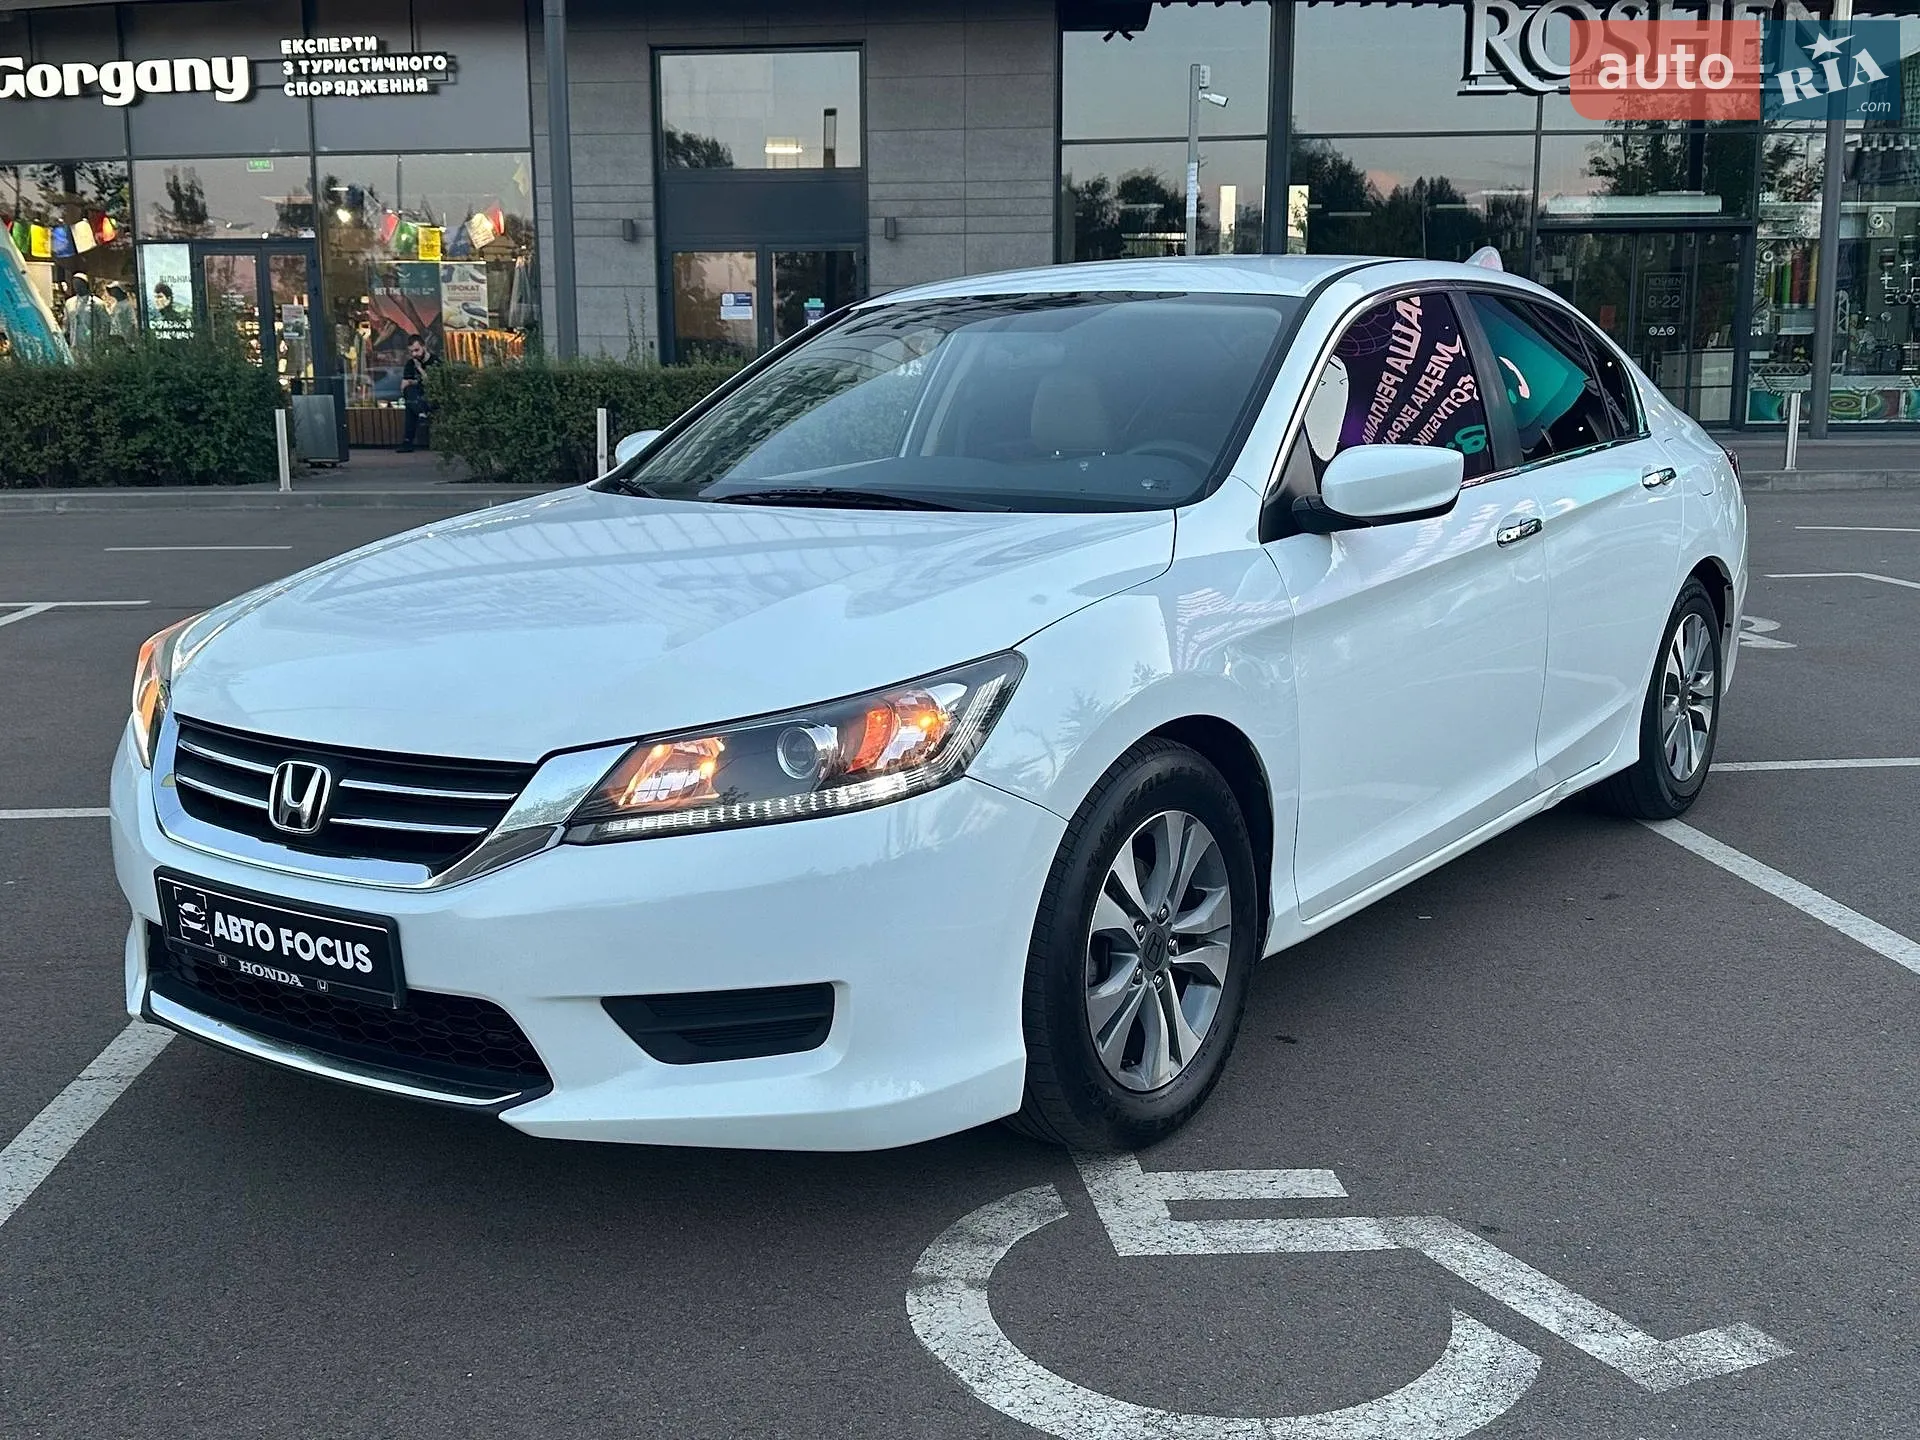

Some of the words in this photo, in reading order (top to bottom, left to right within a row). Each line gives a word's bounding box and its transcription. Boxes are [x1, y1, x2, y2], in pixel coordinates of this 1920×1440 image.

[280, 36, 377, 54] ЕКСПЕРТИ
[1471, 0, 1834, 92] ROSHEN
[282, 61, 294, 76] З
[298, 55, 447, 75] ТУРИСТИЧНОГО
[0, 56, 249, 106] Gorgany
[283, 77, 429, 97] СПОРЯДЖЕННЯ
[214, 911, 275, 951] АВТО
[279, 927, 373, 973] FOCUS
[239, 960, 304, 987] HONDA
